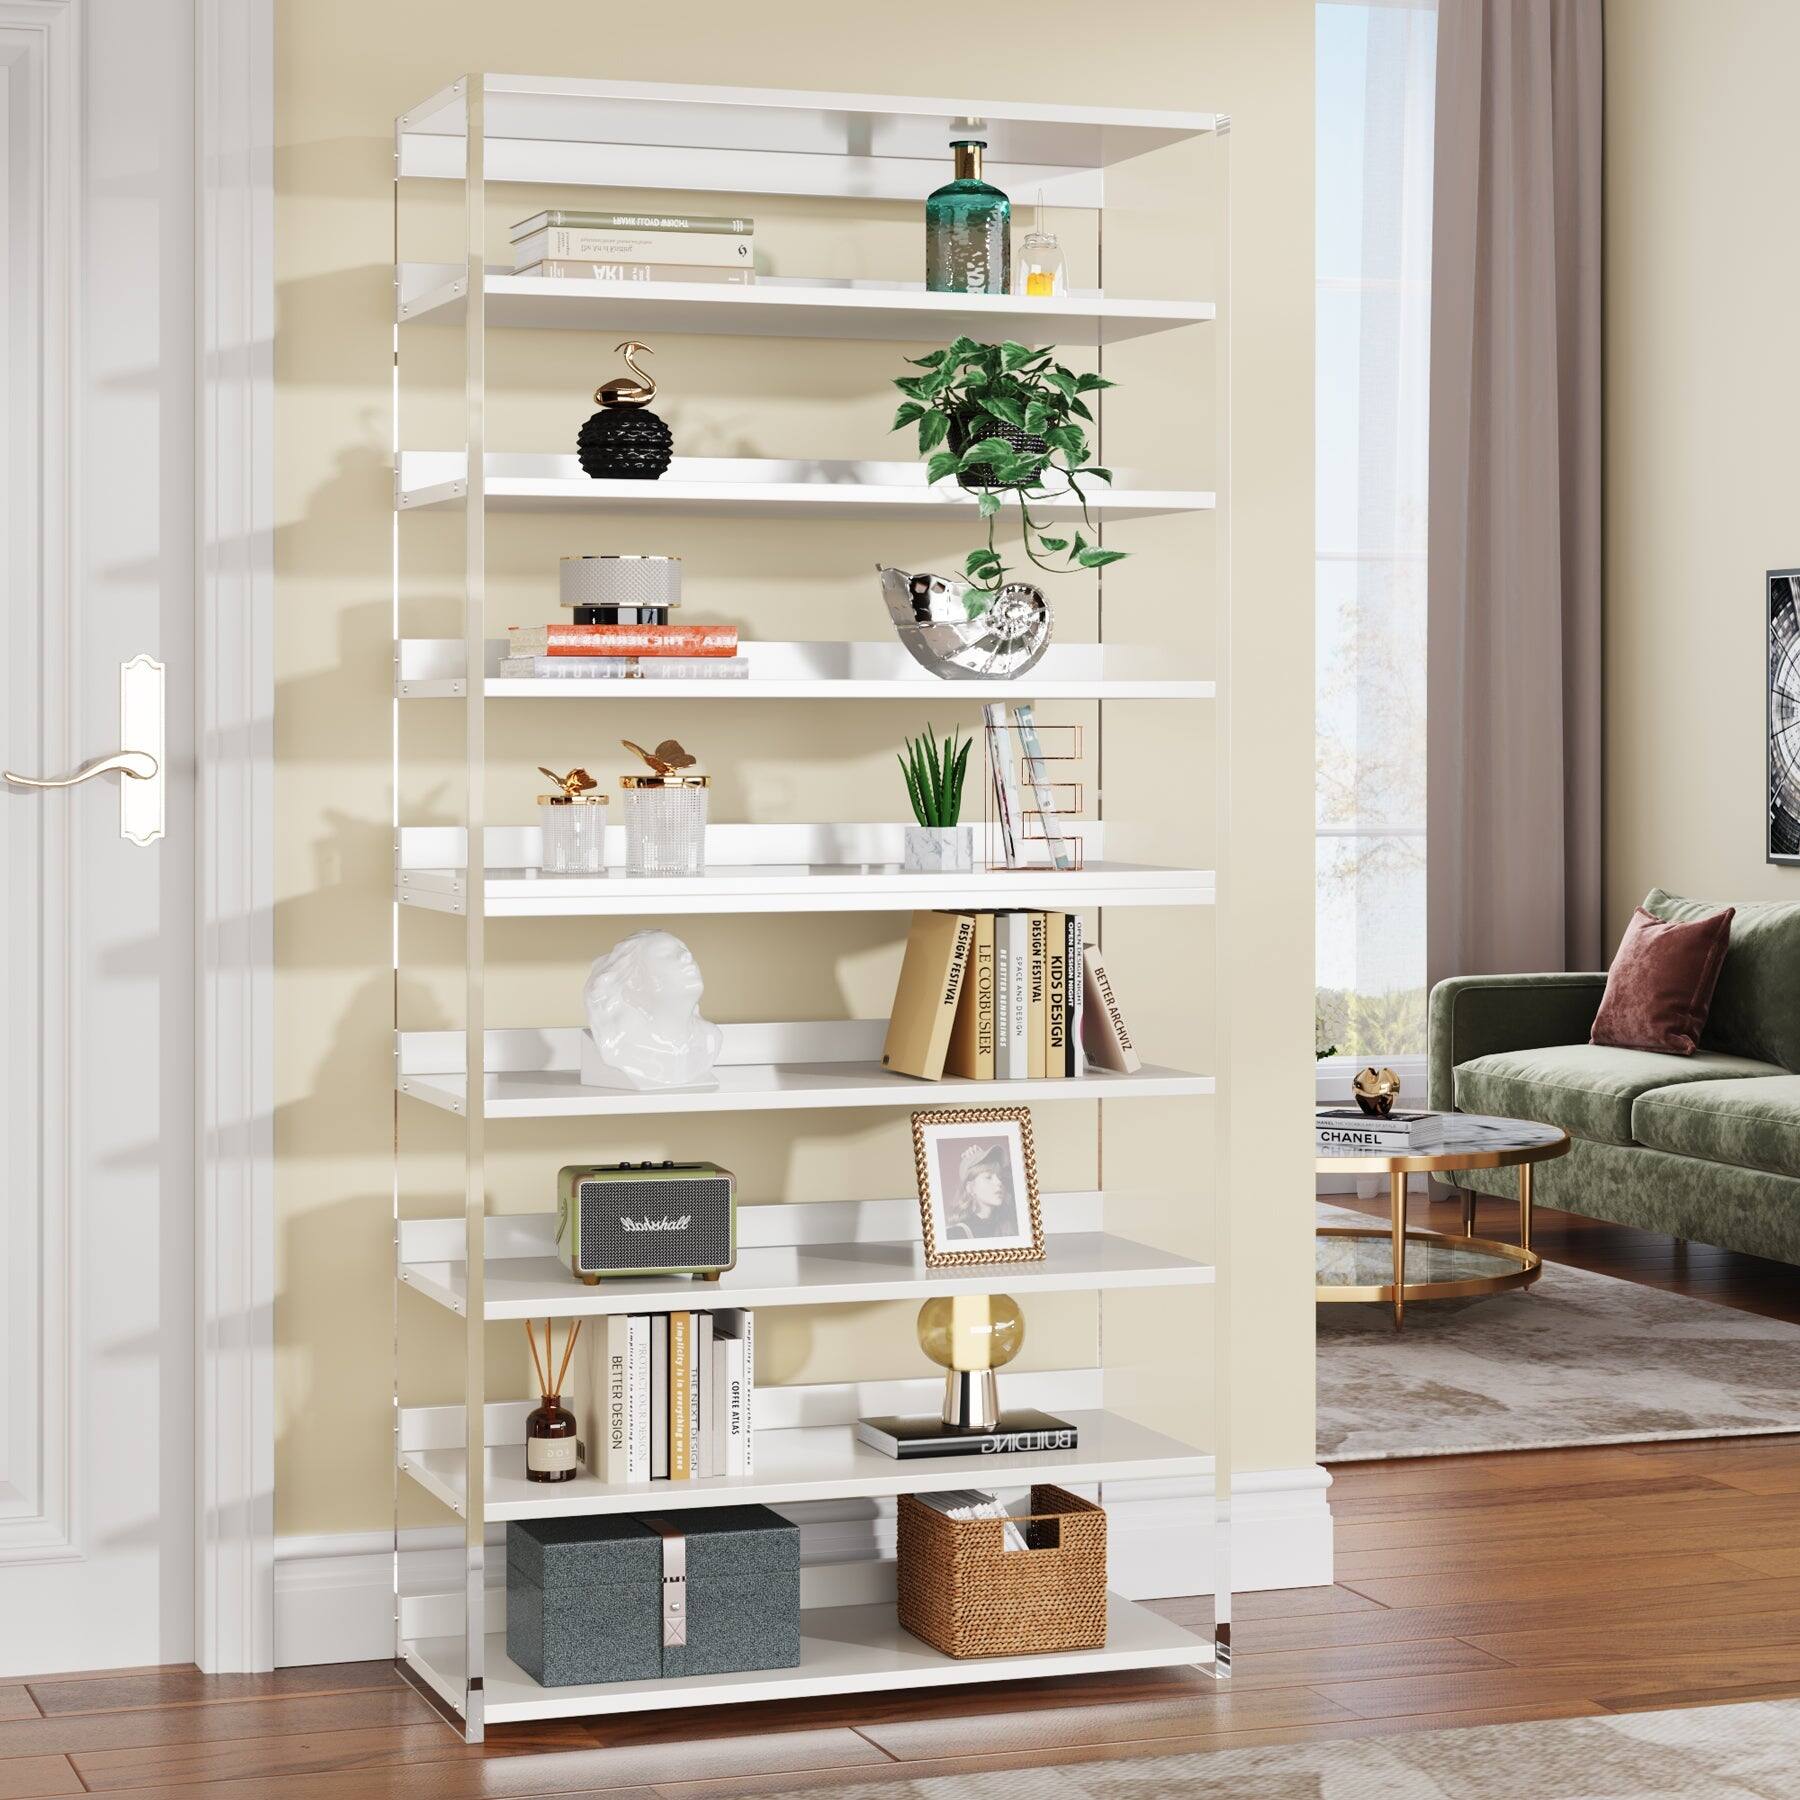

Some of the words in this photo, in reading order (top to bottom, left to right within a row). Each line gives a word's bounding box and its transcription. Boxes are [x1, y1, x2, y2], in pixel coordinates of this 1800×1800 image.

[954, 923, 970, 960] DESIGN
[979, 944, 991, 963] LE
[1032, 921, 1041, 955] DESIGN
[944, 961, 962, 1006] FESTIVAL
[1032, 960, 1041, 1003] FESTIVAL
[1051, 957, 1063, 990] KIDS
[979, 967, 991, 1055] CORBUSIER
[1051, 994, 1063, 1047] DESIGN
[1094, 967, 1114, 1006] BETTER
[1110, 1006, 1134, 1052] ARCHVIZ
[1321, 1131, 1382, 1144] CHANEL
[620, 1215, 692, 1232] Marshall
[675, 1321, 685, 1366] simplicity
[612, 1356, 622, 1399] BETTER
[638, 1343, 647, 1391] PROTECT
[676, 1368, 683, 1377] is
[676, 1379, 683, 1388] in
[638, 1394, 647, 1418] OUR
[675, 1391, 685, 1438] everything
[612, 1403, 622, 1450] DESIGN
[638, 1421, 647, 1461] DESIGN
[676, 1441, 683, 1452] we
